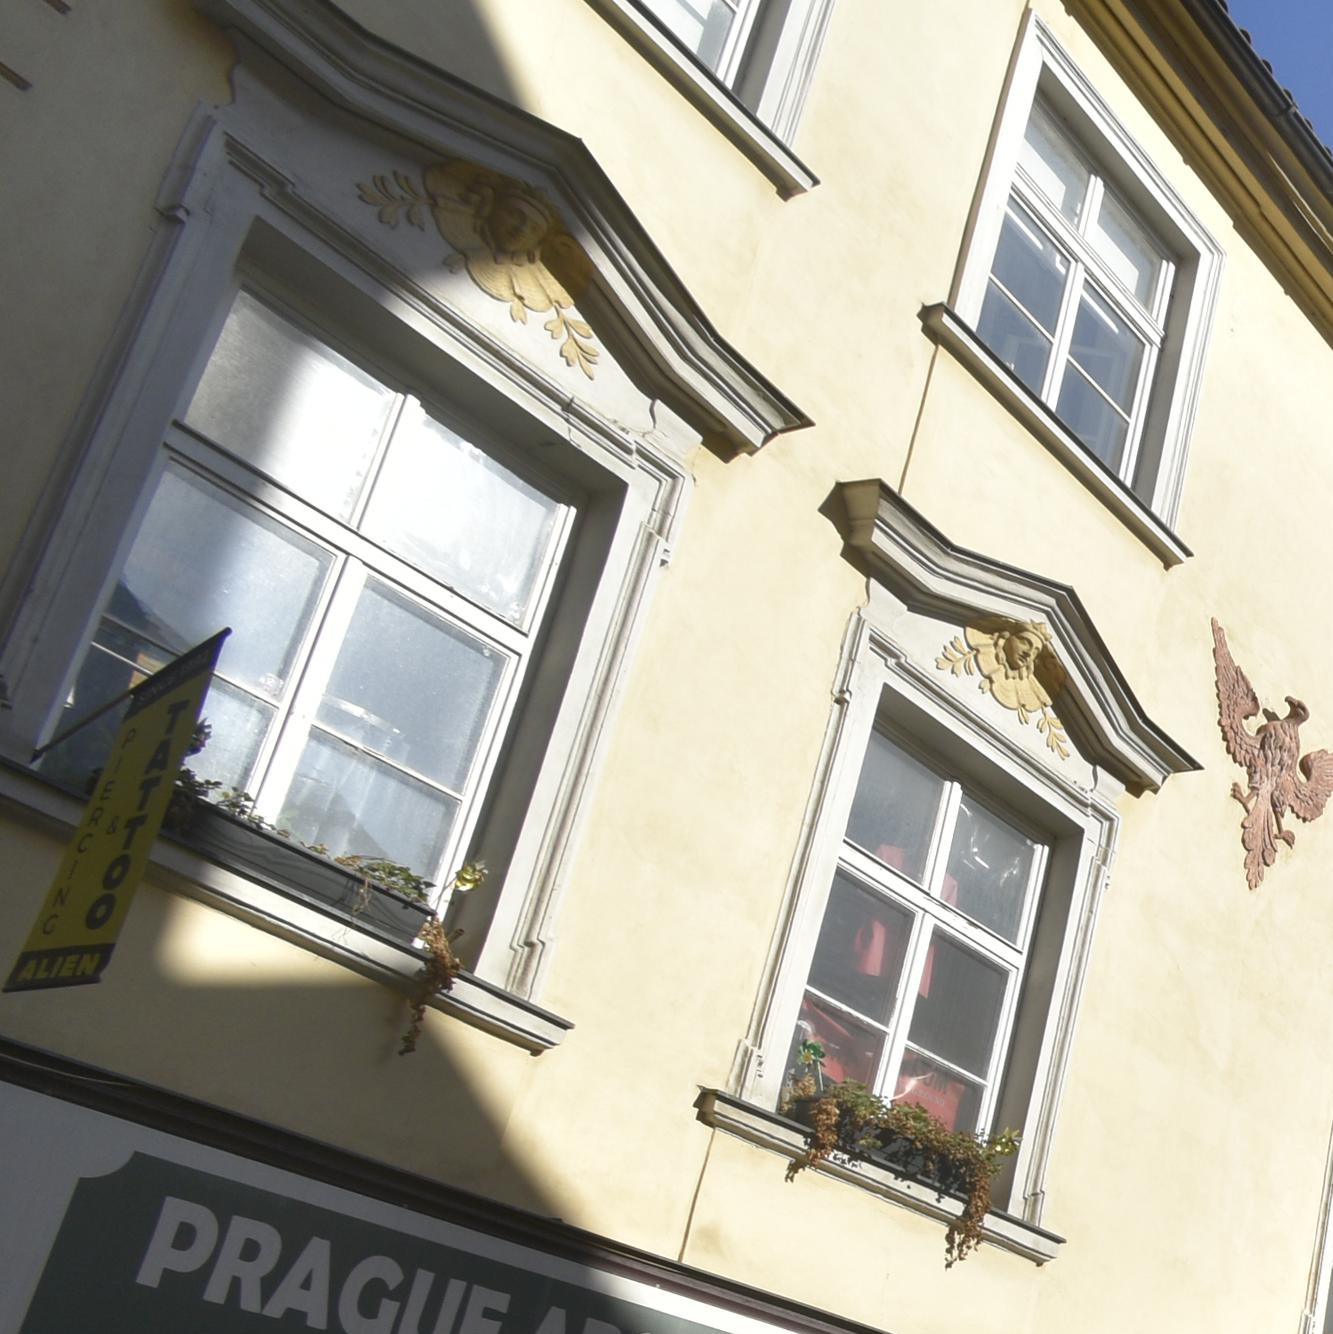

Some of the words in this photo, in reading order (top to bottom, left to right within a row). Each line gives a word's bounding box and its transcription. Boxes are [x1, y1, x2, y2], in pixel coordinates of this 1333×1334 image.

[86, 698, 189, 931] TATTOO
[106, 814, 118, 835] &
[19, 953, 100, 983] ALIEN
